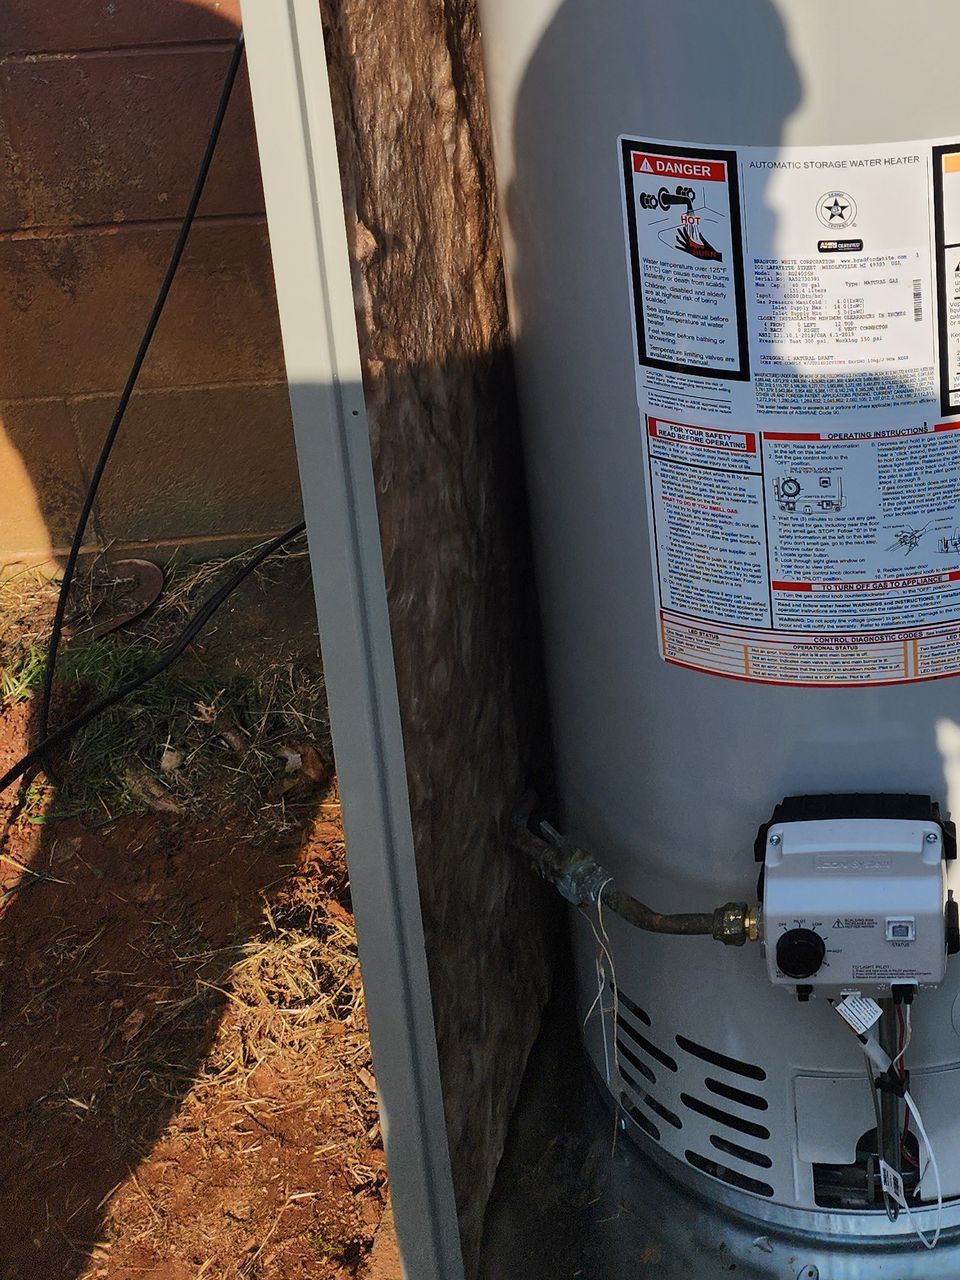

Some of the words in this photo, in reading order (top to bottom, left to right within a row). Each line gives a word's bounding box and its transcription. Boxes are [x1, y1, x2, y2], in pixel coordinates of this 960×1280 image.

[750, 161, 801, 169] AUTOMATIC
[803, 160, 847, 169] STORAGE
[849, 158, 881, 168] WATER
[884, 155, 920, 166] HEATER
[656, 161, 711, 177] DANGER
[680, 215, 701, 224] HOT
[692, 249, 717, 258] BURN
[642, 257, 659, 266] Water
[660, 260, 693, 271] temperature
[673, 276, 690, 284] death
[670, 285, 693, 295] disabled
[701, 297, 717, 305] being
[687, 312, 709, 320] manual
[710, 314, 729, 322] before
[677, 332, 695, 340] before
[696, 335, 717, 345] bathing
[669, 425, 683, 433] FOR
[685, 429, 704, 437] YOUR
[705, 432, 732, 441] SAFETY
[827, 432, 871, 440] OPERATING
[873, 426, 929, 438] INSTRUCTIONS
[658, 429, 675, 438] READ
[677, 433, 704, 443] BEFORE
[705, 437, 746, 449] OPERATING
[709, 505, 726, 513] SMELL
[901, 576, 942, 586] APPLIANCE
[699, 631, 720, 640] STATUS
[849, 634, 896, 642] DIAGNOSTIC
[898, 631, 923, 639] CODES
